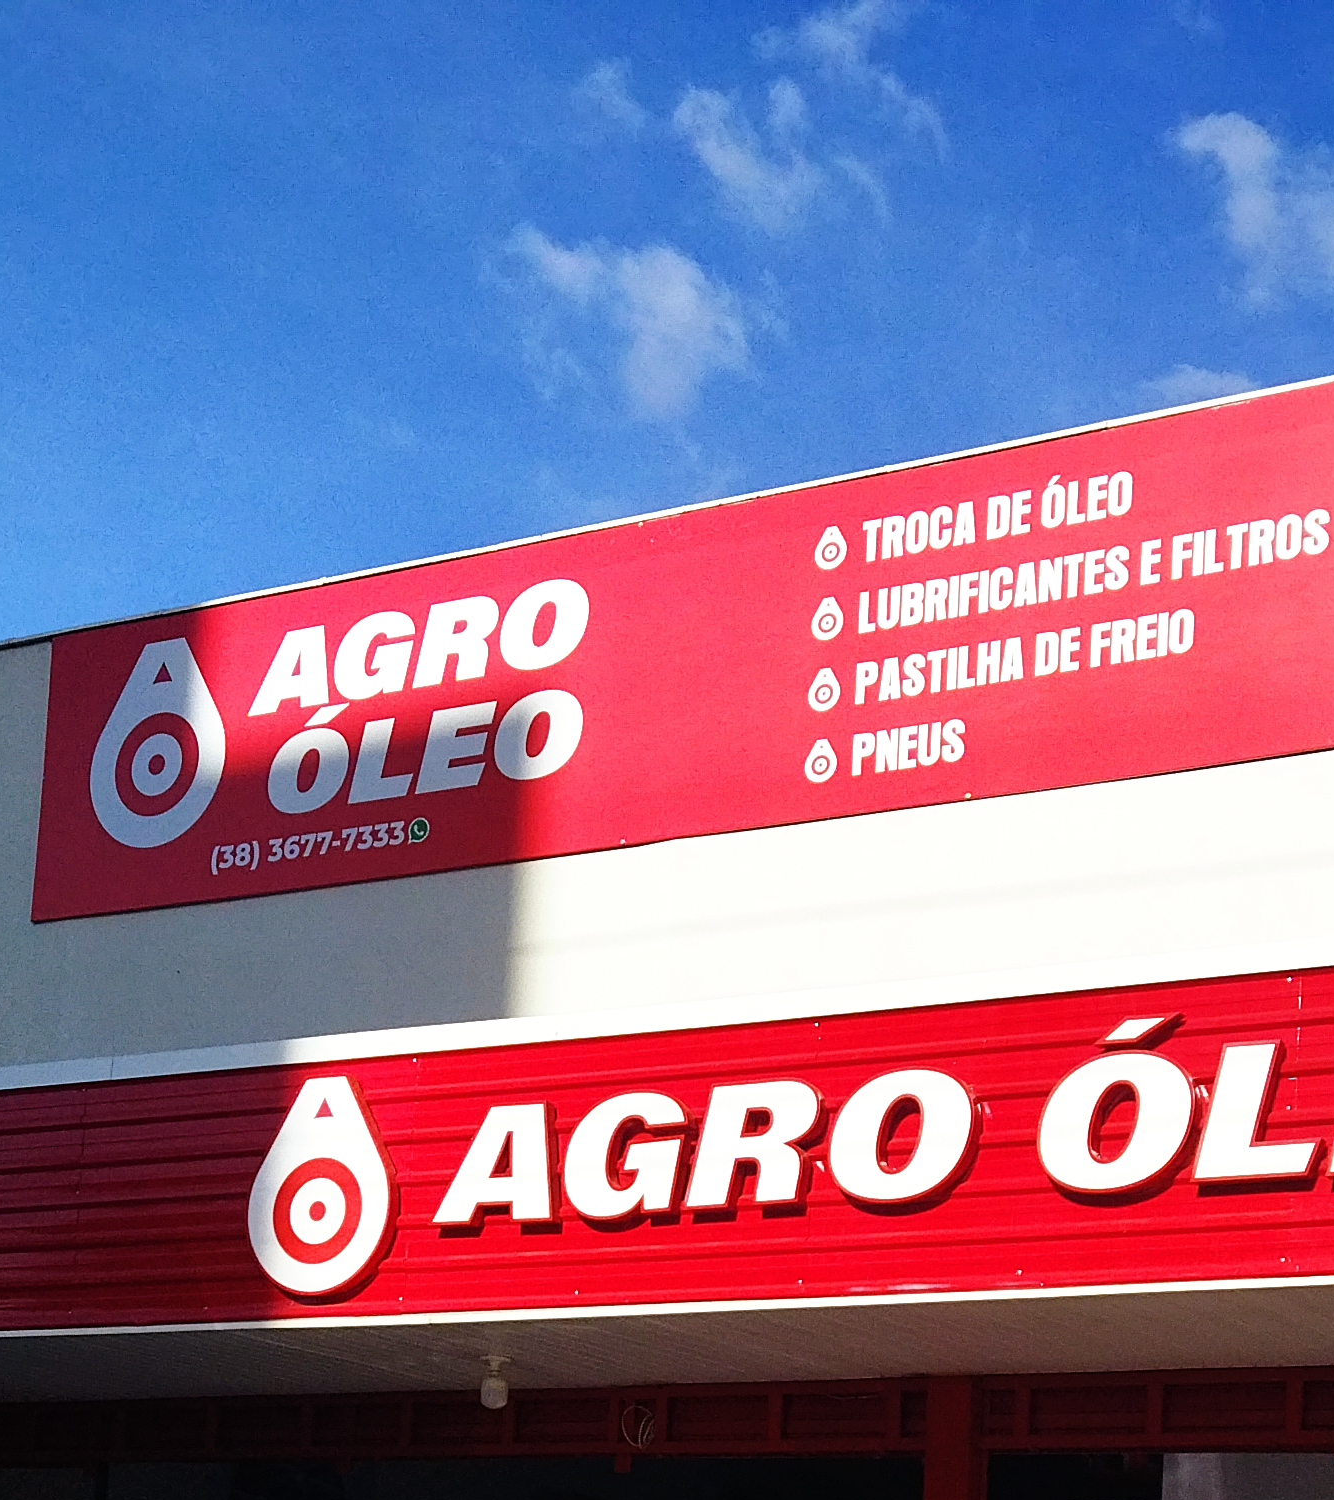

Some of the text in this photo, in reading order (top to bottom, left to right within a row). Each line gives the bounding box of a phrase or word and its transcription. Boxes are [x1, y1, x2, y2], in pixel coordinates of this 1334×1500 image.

[857, 508, 1331, 634] LUBRIFICANTES E FILTROS
[862, 471, 1134, 563] TROCA DE ÓLEO
[247, 578, 590, 717] AGRO
[854, 608, 1196, 706] PASTILHA DE FREIO
[267, 689, 584, 814] ÓLEO
[851, 718, 966, 777] PNEUS
[210, 820, 406, 875] (38) 3677-7333
[432, 1069, 975, 1226] AGRO
